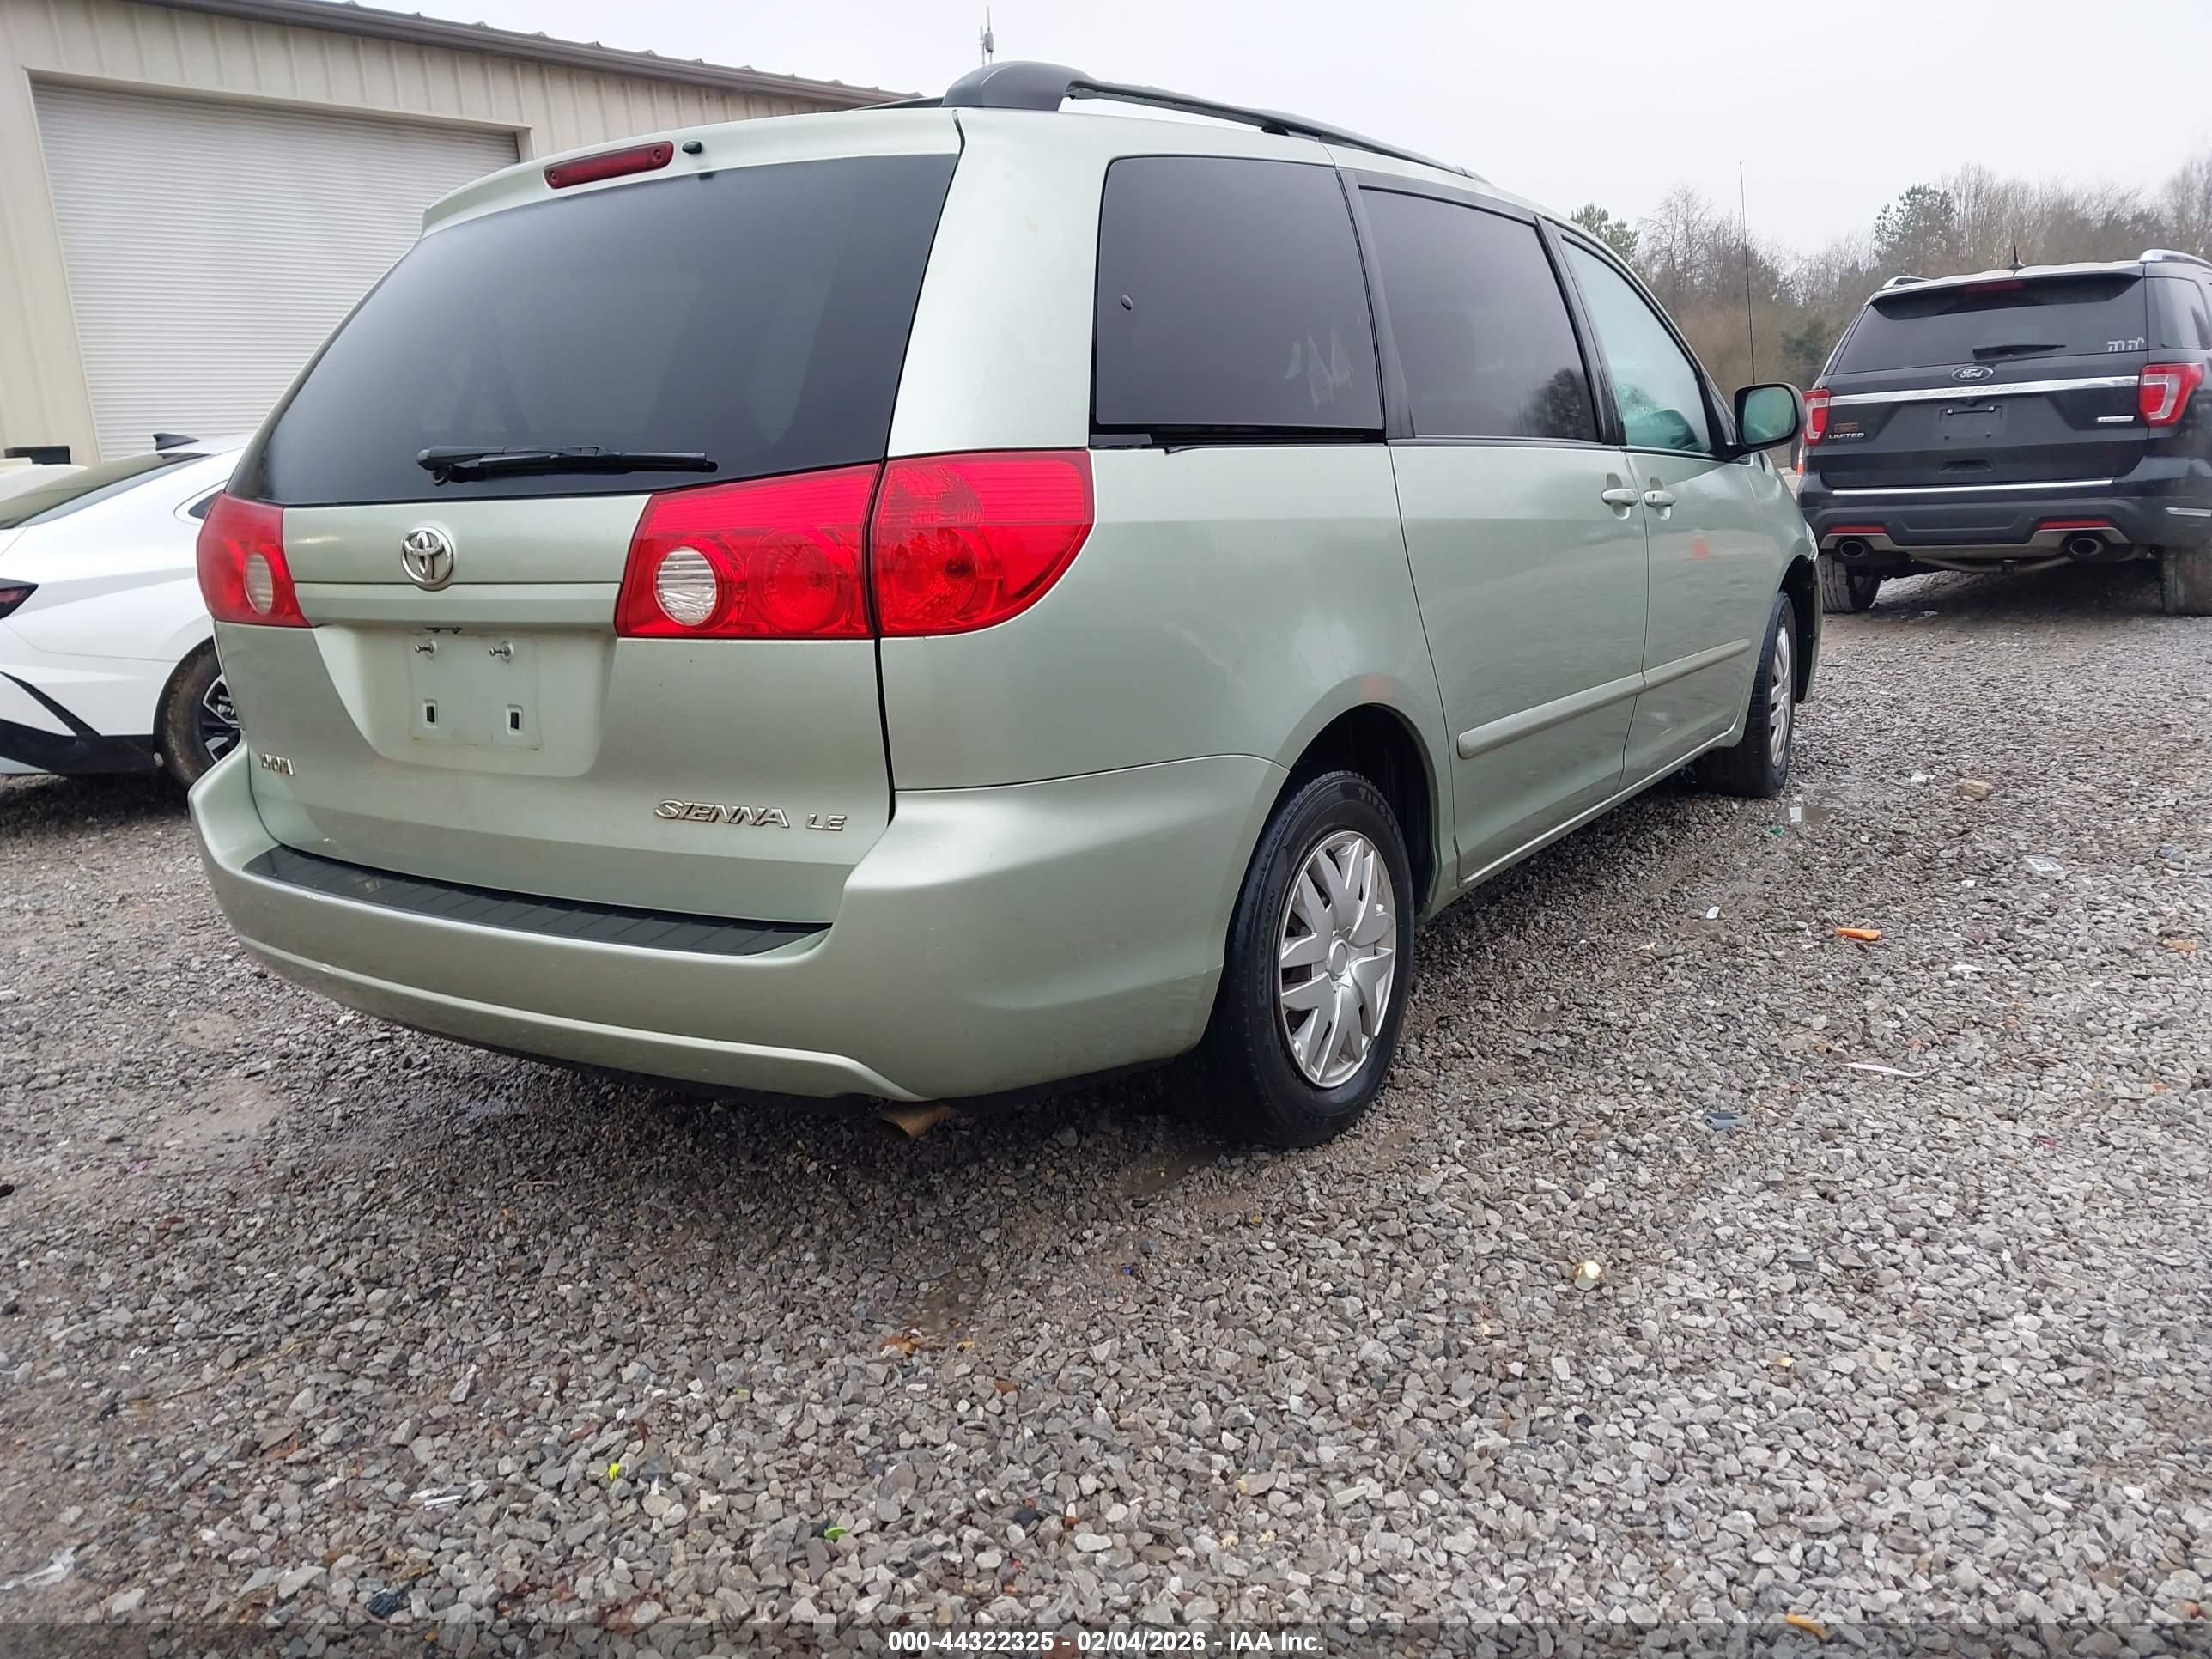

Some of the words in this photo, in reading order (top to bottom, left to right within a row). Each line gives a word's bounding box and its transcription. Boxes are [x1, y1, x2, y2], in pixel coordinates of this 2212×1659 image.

[1960, 368, 1983, 379] Ford
[1917, 385, 2027, 398] EXPLORER
[653, 799, 791, 829] SIENNA
[805, 812, 847, 832] LE
